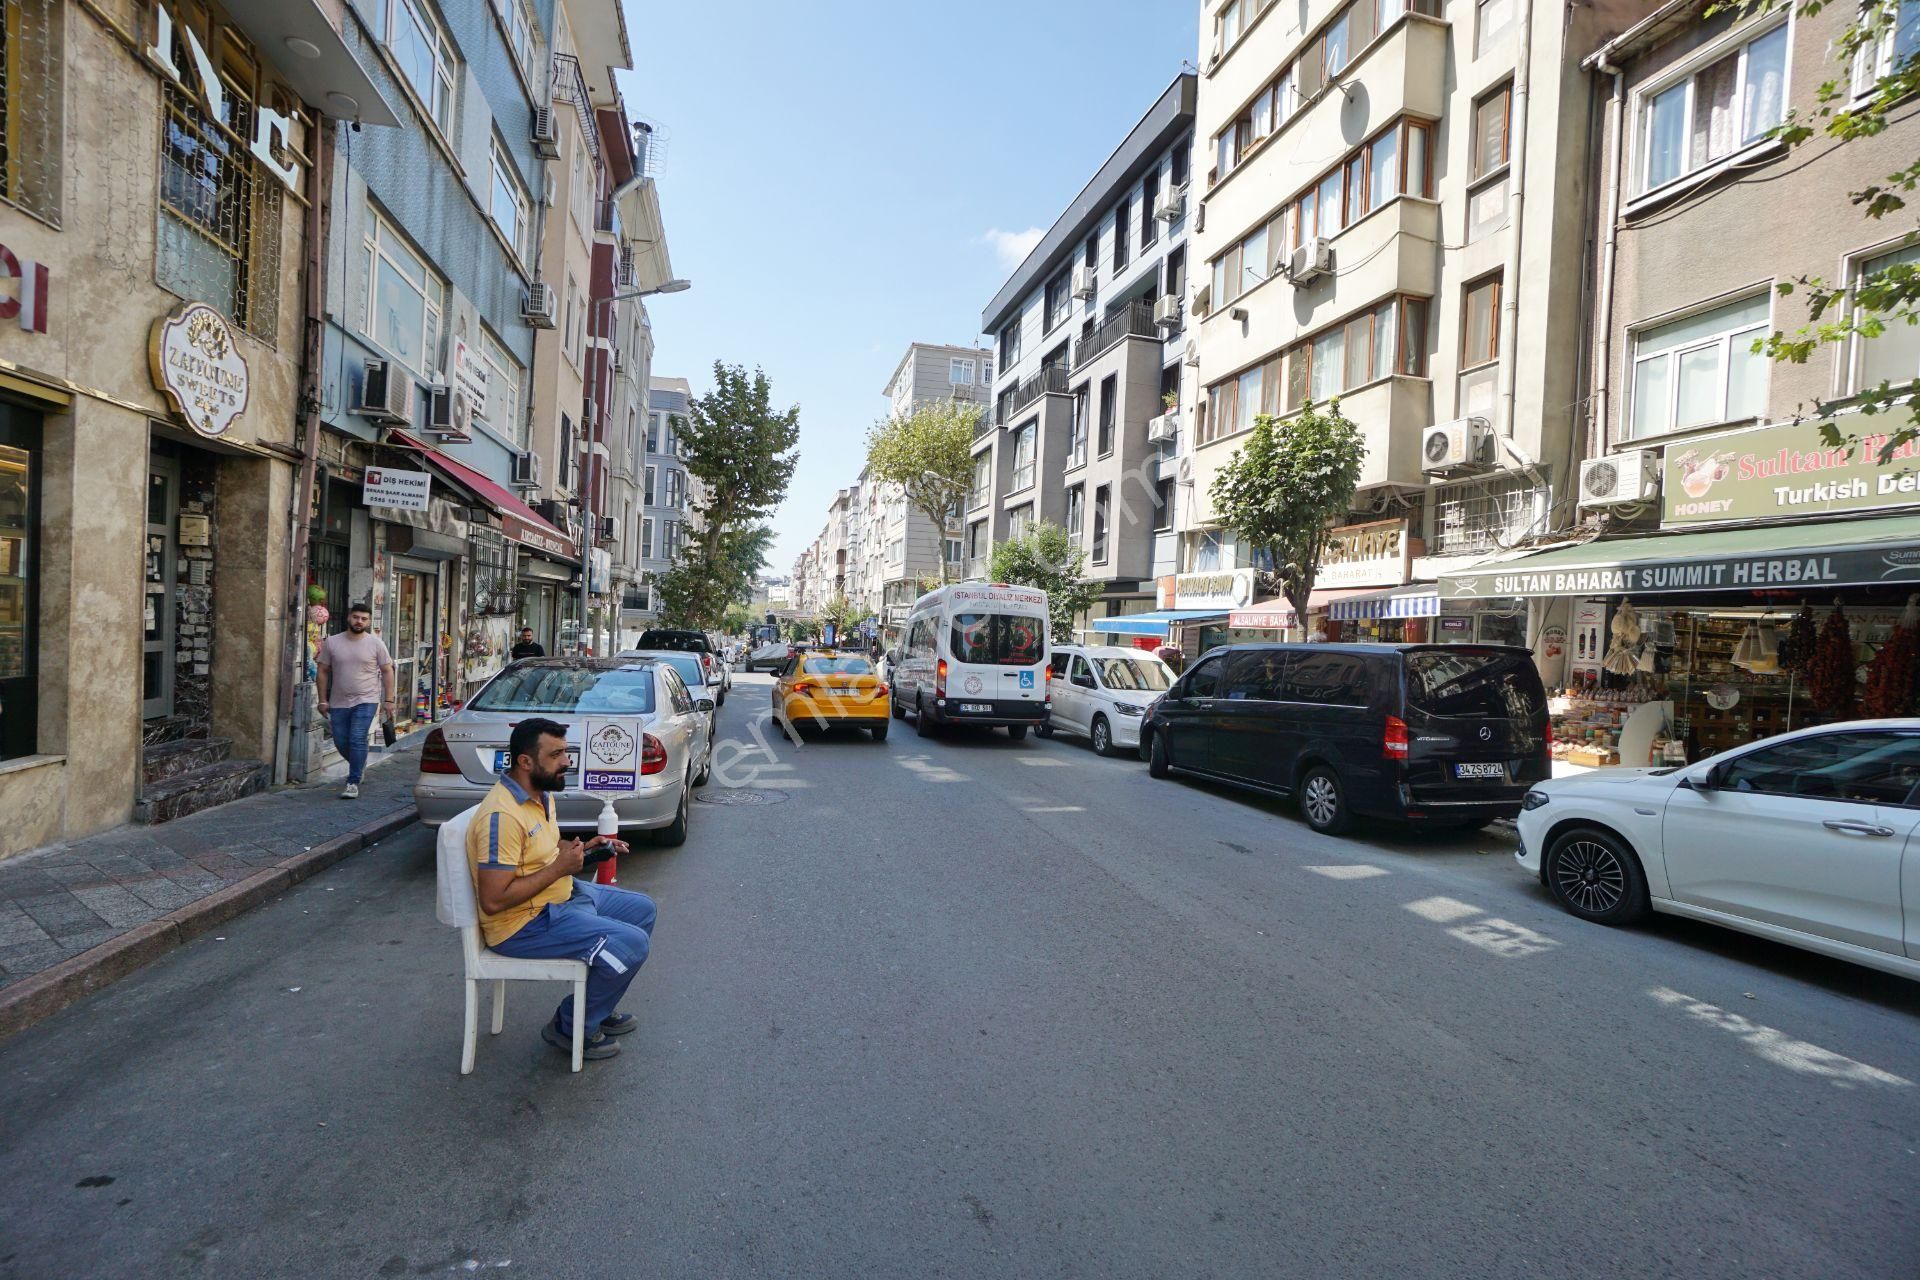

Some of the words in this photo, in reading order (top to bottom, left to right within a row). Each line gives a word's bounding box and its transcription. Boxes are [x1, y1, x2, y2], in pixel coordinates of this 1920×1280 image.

[177, 374, 236, 406] SWEETS
[1738, 446, 1849, 481] Sultan
[383, 476, 396, 485] DİŞ
[399, 478, 426, 488] HEKİMİ
[1773, 477, 1868, 506] Turkish
[1675, 498, 1734, 516] HONEY
[1494, 574, 1550, 594] SULTAN
[1555, 569, 1636, 591] BAHARAT
[1641, 563, 1726, 588] SUMMIT
[1733, 557, 1837, 584] HERBAL
[1460, 764, 1470, 774] 34
[1471, 764, 1482, 774] ZS
